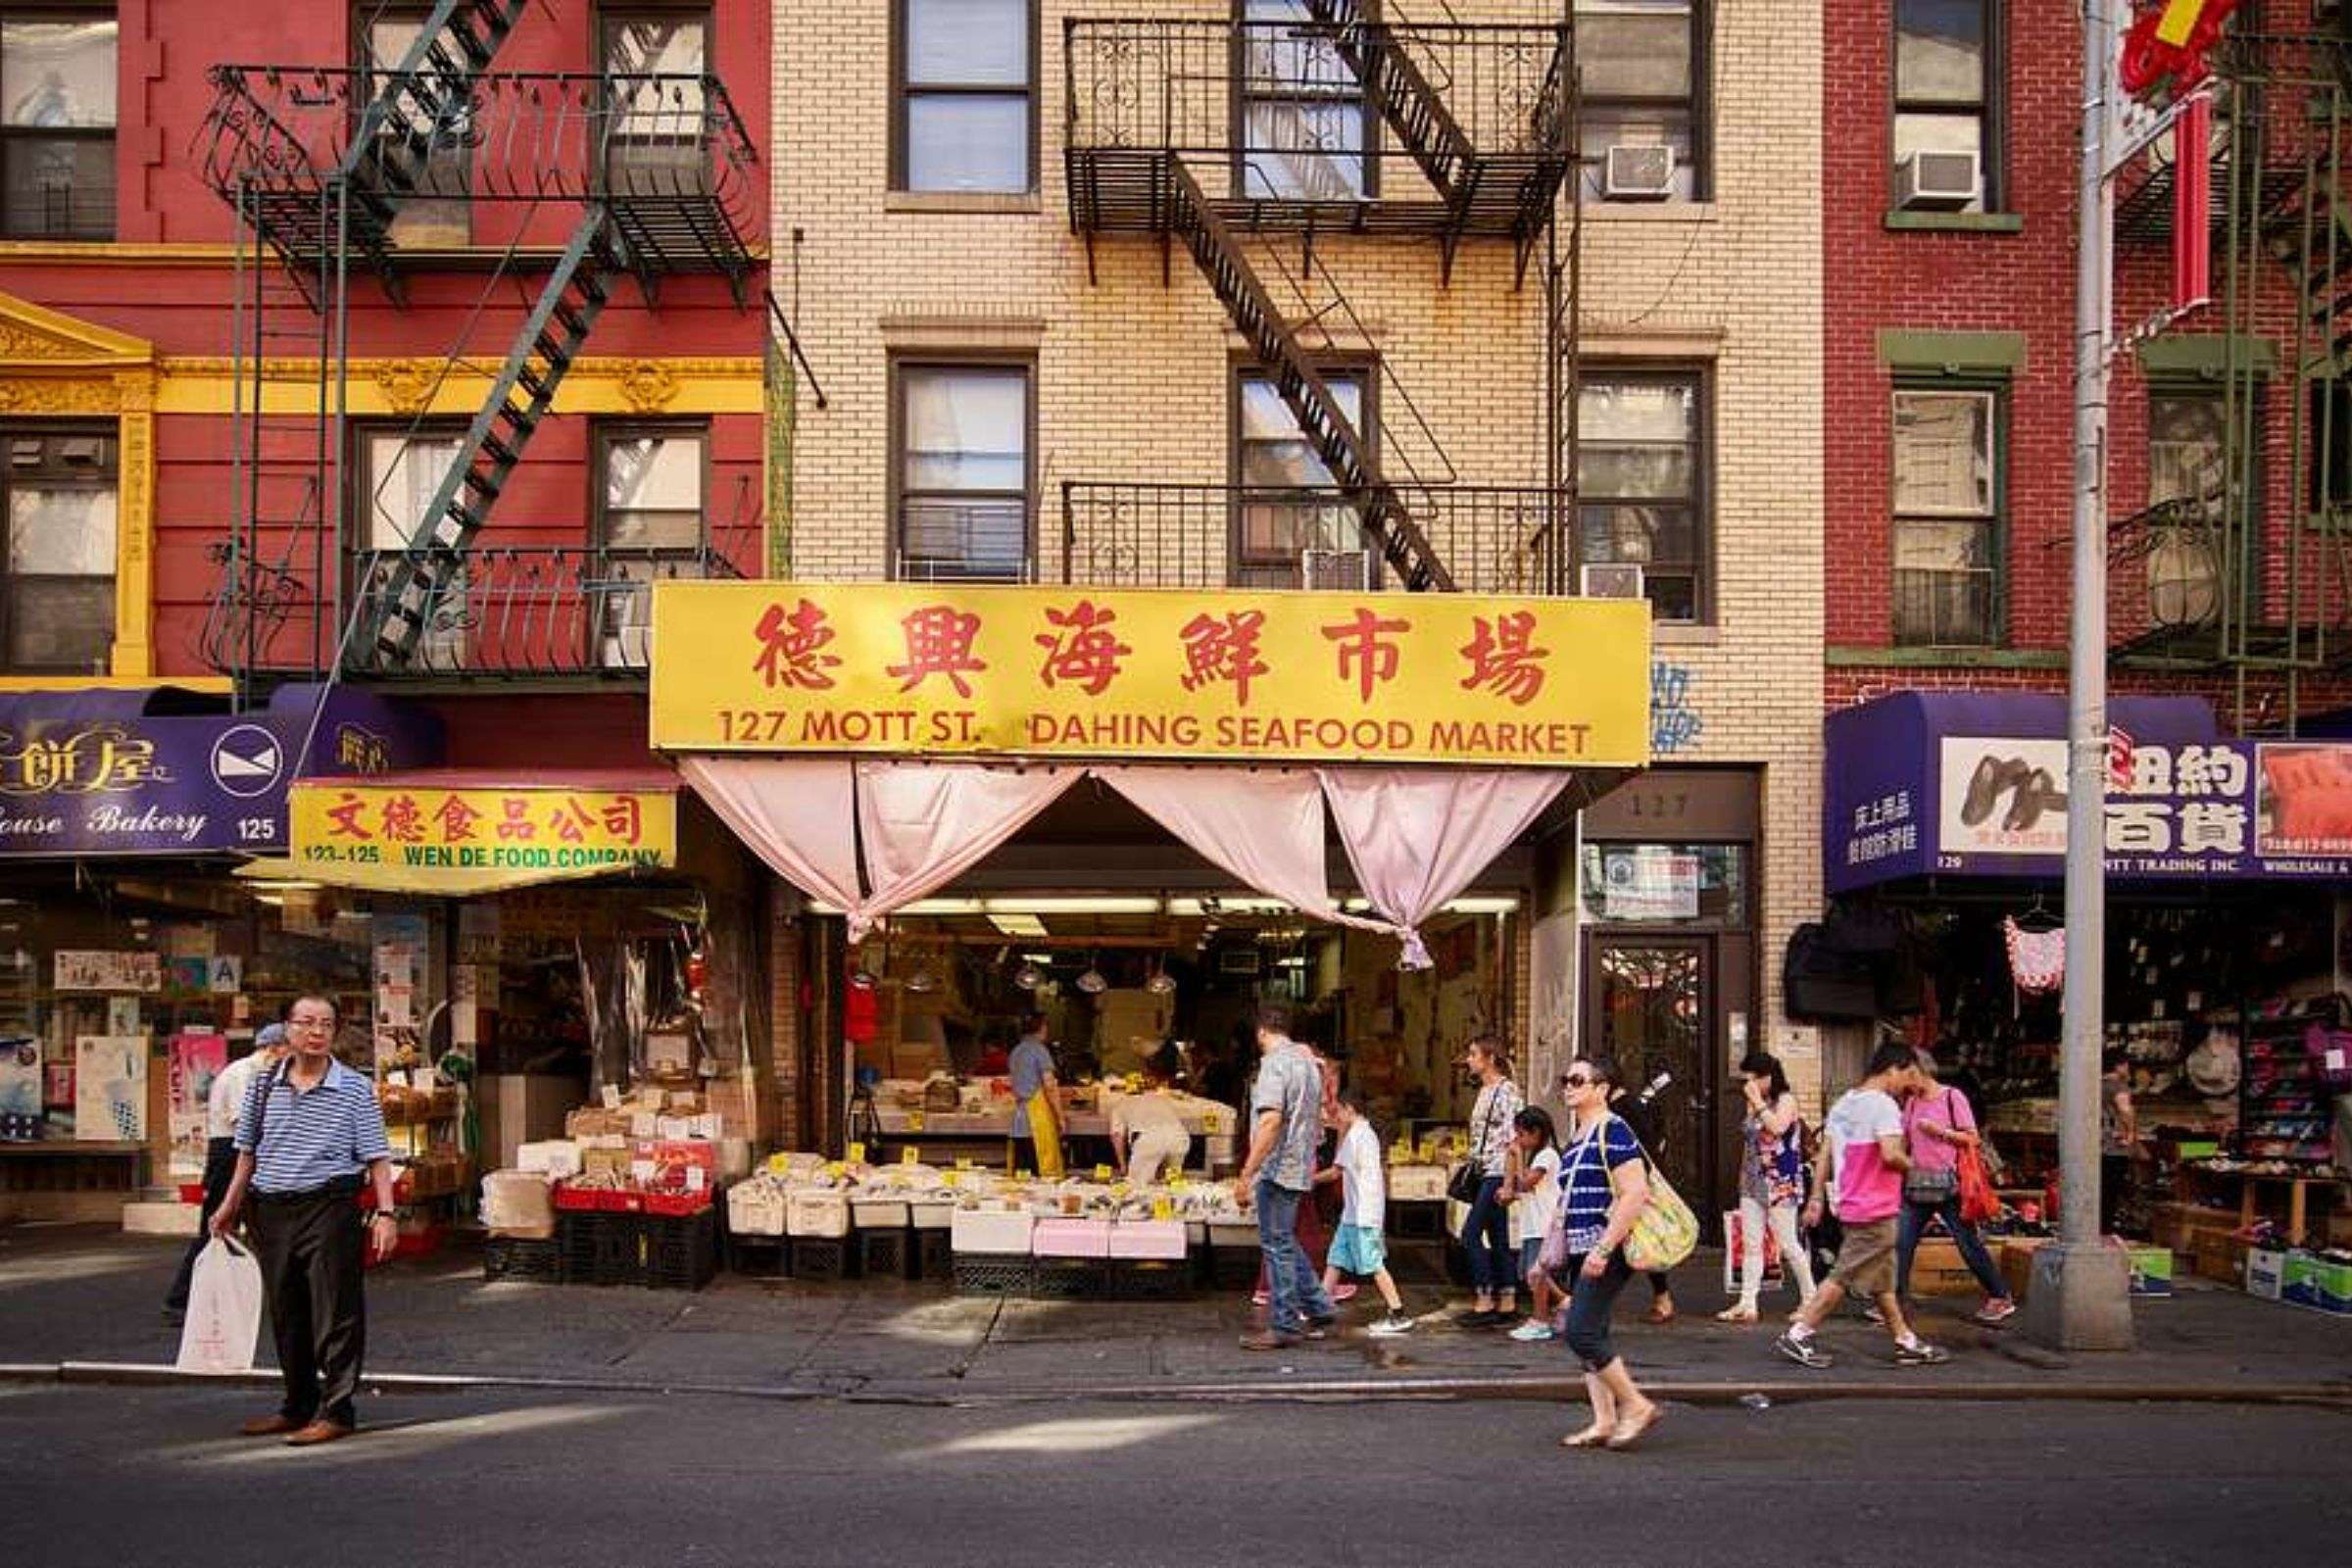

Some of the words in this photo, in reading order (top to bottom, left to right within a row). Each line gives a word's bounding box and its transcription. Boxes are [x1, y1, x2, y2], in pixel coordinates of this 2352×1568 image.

[753, 598, 1550, 707] 德興海鮮市場
[718, 711, 785, 742] 127
[801, 710, 916, 742] MOTT
[931, 711, 981, 743] ST.
[1031, 713, 1201, 746] DAHING
[1216, 716, 1414, 751] SEAFOOD
[1429, 720, 1592, 754] MARKET
[0, 726, 157, 793] 餅屋
[0, 807, 63, 834] ouse
[86, 805, 208, 840] Bakery
[237, 819, 275, 840] 125
[327, 792, 642, 844] 文德食品公司
[2104, 803, 2247, 853] 百貨
[305, 845, 379, 863] 123-125
[404, 846, 452, 866] WEN
[462, 847, 487, 867] DE
[494, 847, 553, 868] FOOD
[558, 847, 662, 868] COMPANY
[1936, 856, 1962, 868] 129
[2137, 858, 2205, 871] TRADING
[2262, 859, 2334, 873] WHOLESALE
[218, 960, 233, 979] A
